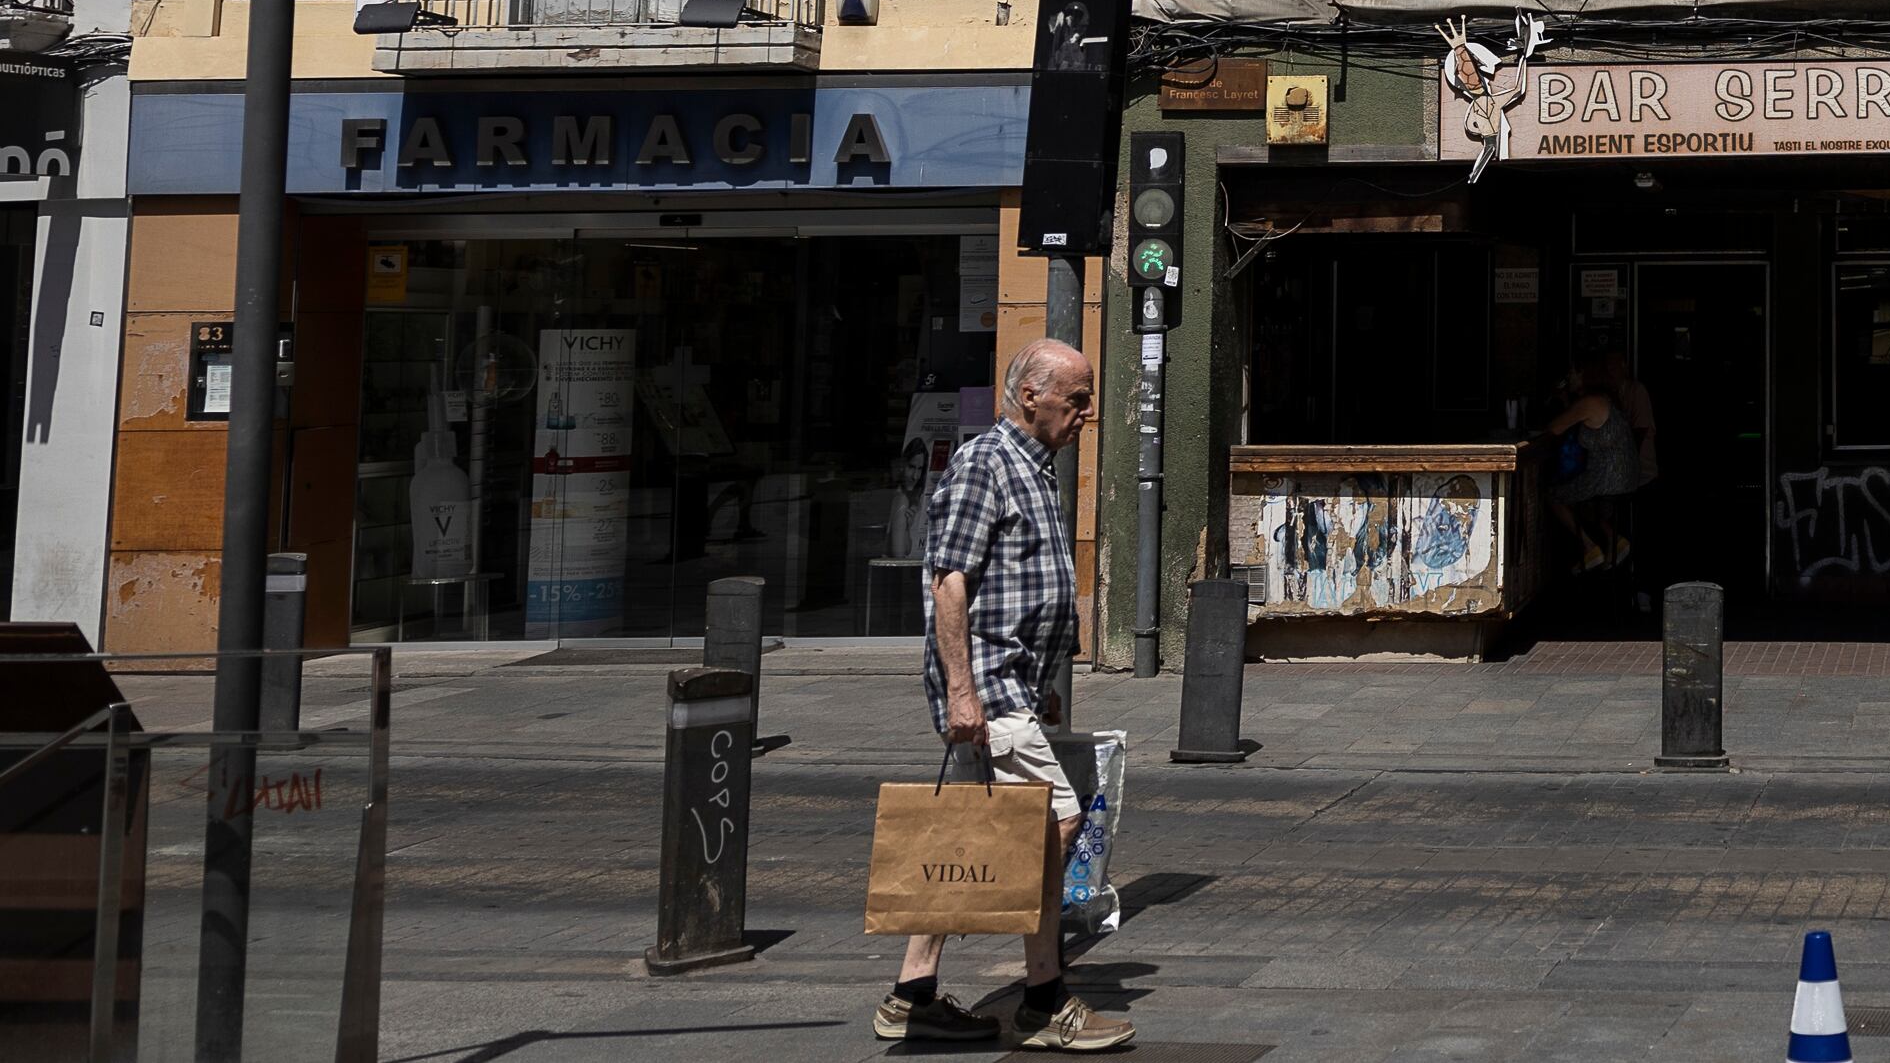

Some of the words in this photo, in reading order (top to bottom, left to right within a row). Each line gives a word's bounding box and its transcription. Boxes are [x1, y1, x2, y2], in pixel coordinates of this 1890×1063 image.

[1169, 89, 1219, 99] Francesc
[1224, 89, 1259, 101] Layret
[1538, 70, 1671, 124] BAR
[340, 113, 892, 168] FARMACIA
[1537, 134, 1635, 154] AMBIENT
[1644, 132, 1753, 153] ESPORTIU
[1774, 140, 1801, 151] TASTI
[1805, 140, 1817, 150] EL
[1820, 139, 1862, 150] NOSTRE
[198, 326, 224, 341] 83
[564, 336, 624, 350] VICHY
[430, 505, 456, 514] VICHY
[435, 516, 452, 537] V
[529, 584, 581, 602] -15%
[921, 864, 996, 883] VIDAL
